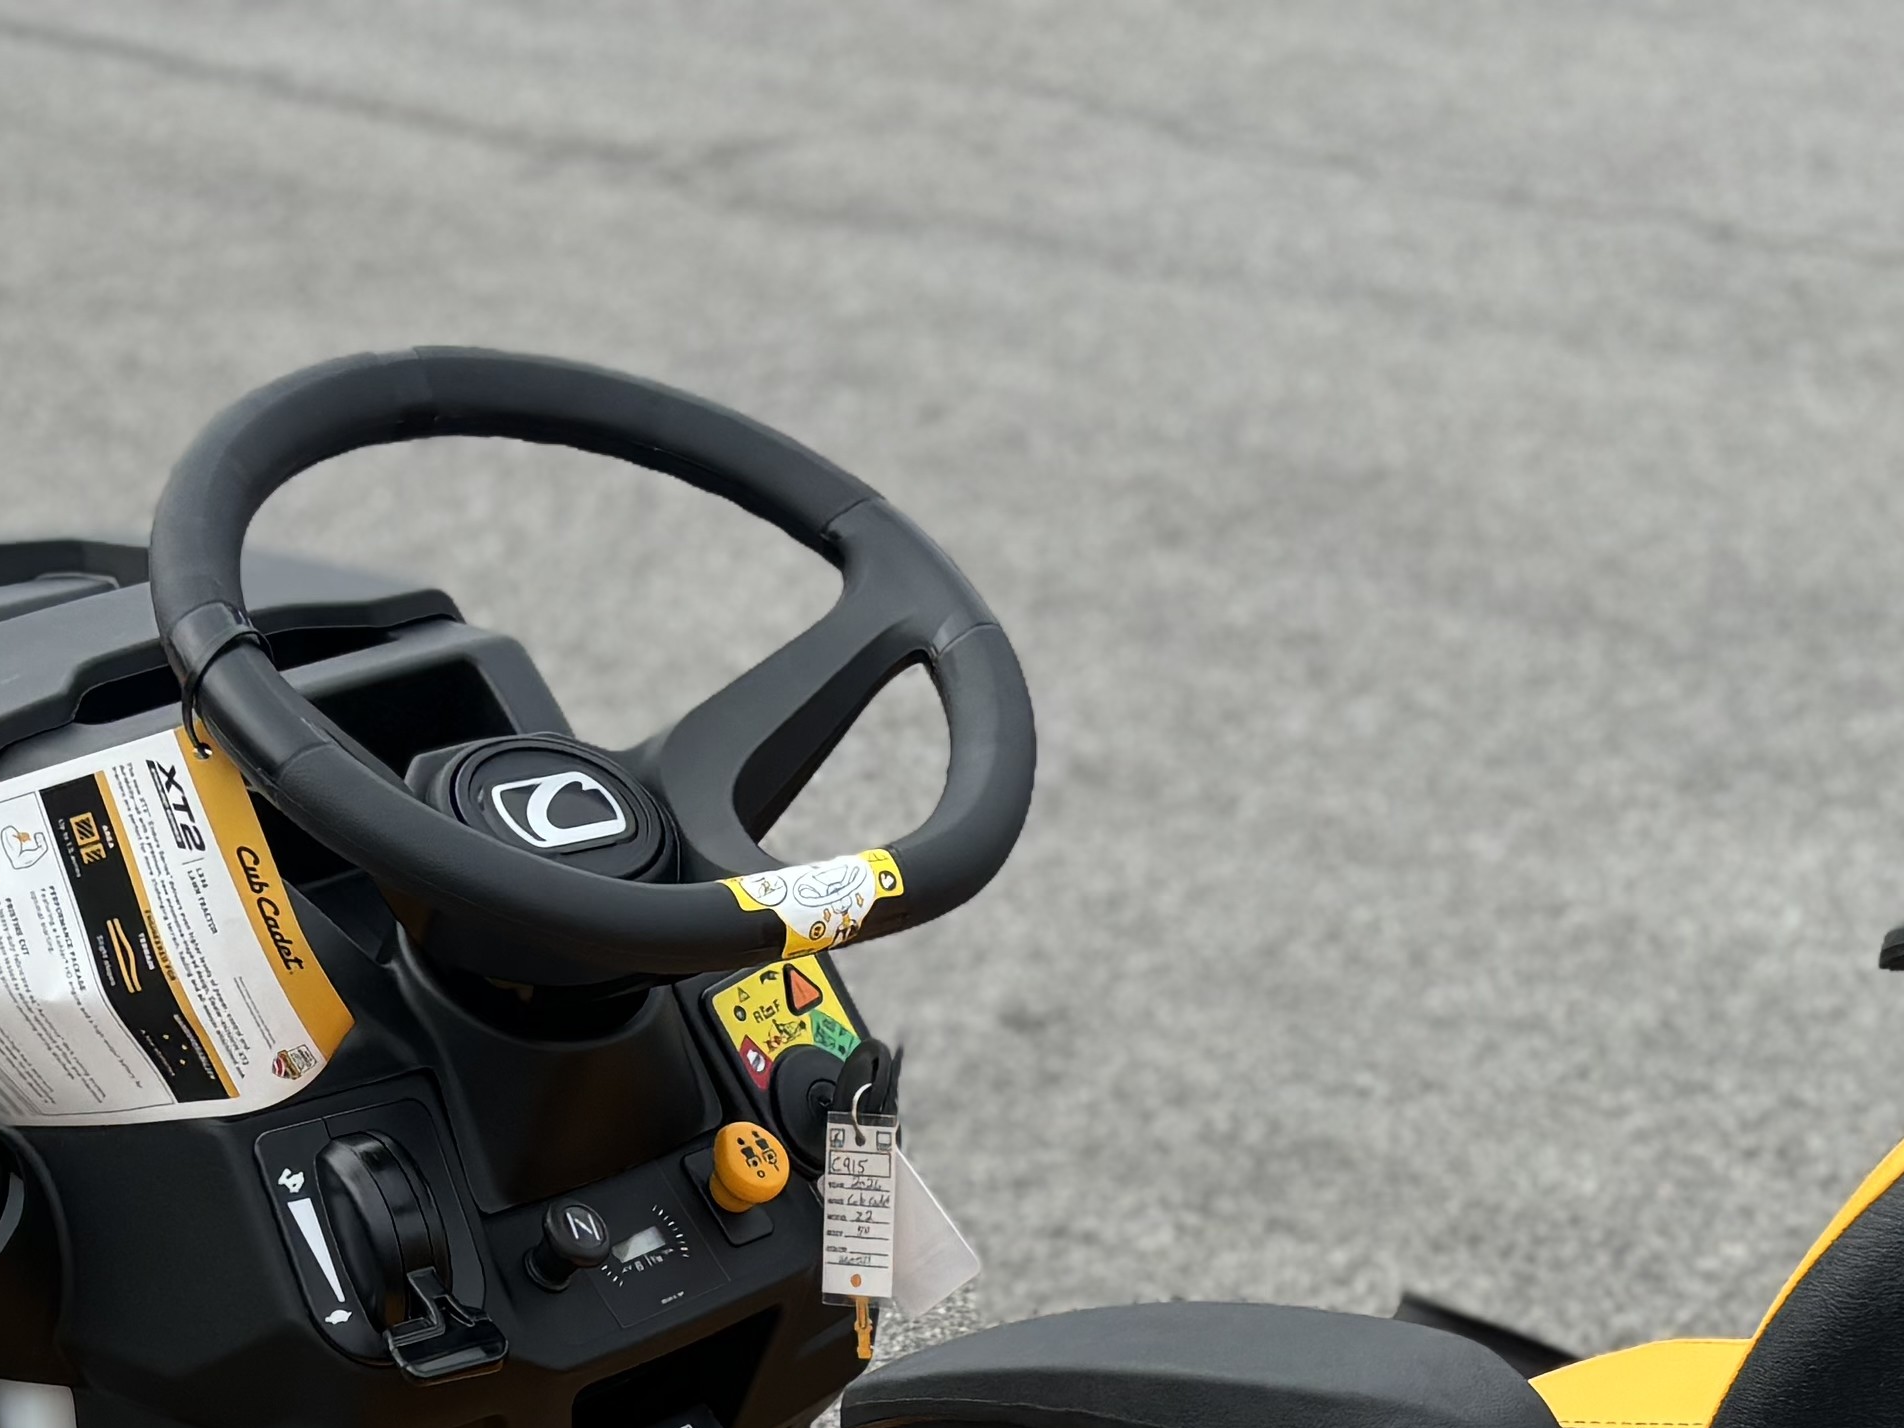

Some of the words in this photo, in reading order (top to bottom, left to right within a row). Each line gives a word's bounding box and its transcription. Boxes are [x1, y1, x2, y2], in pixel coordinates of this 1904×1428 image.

[159, 765, 206, 851] XT2
[236, 846, 269, 894] Cub
[257, 897, 304, 970] Cadet
